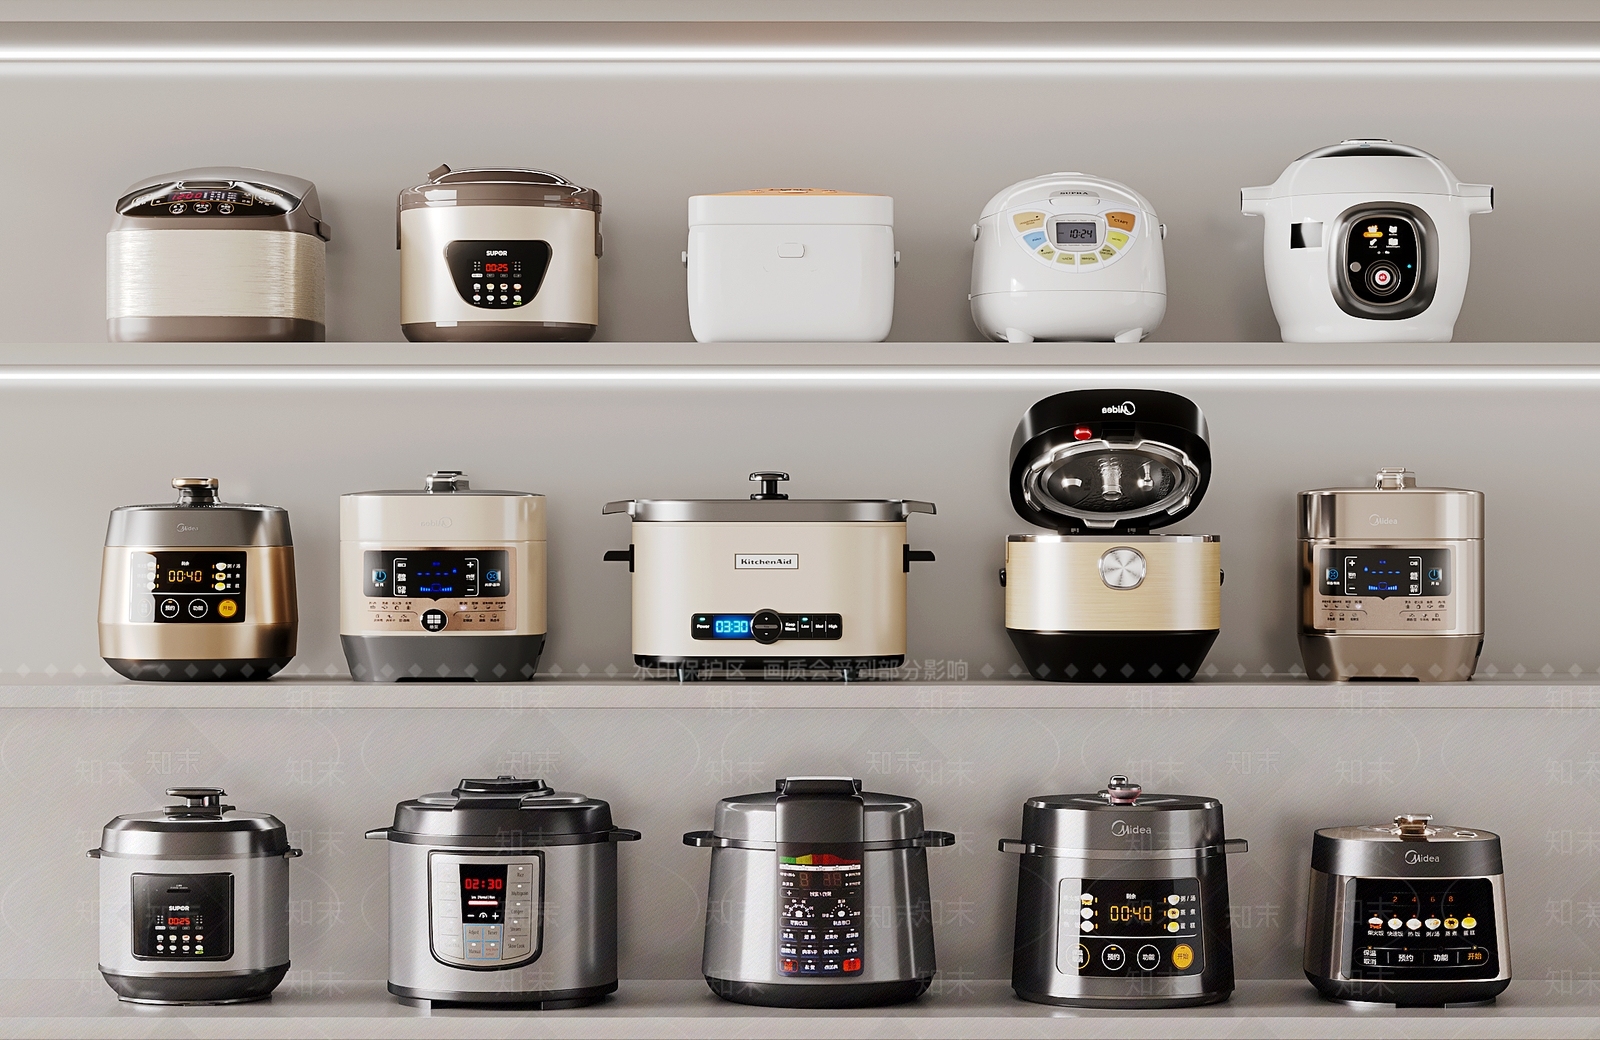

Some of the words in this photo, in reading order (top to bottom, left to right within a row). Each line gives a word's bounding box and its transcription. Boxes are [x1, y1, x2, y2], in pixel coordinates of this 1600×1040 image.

[1069, 229, 1092, 238] 10:24
[485, 263, 508, 272] 00:25
[1368, 514, 1398, 526] Midea
[176, 523, 198, 532] Midea
[168, 570, 202, 582] 00:40
[715, 620, 748, 633] 03:30
[1111, 819, 1152, 837] Midea
[1404, 850, 1440, 865] Midea
[465, 879, 502, 889] 02:30
[1110, 906, 1152, 922] 00:40
[1398, 954, 1414, 962] 预约
